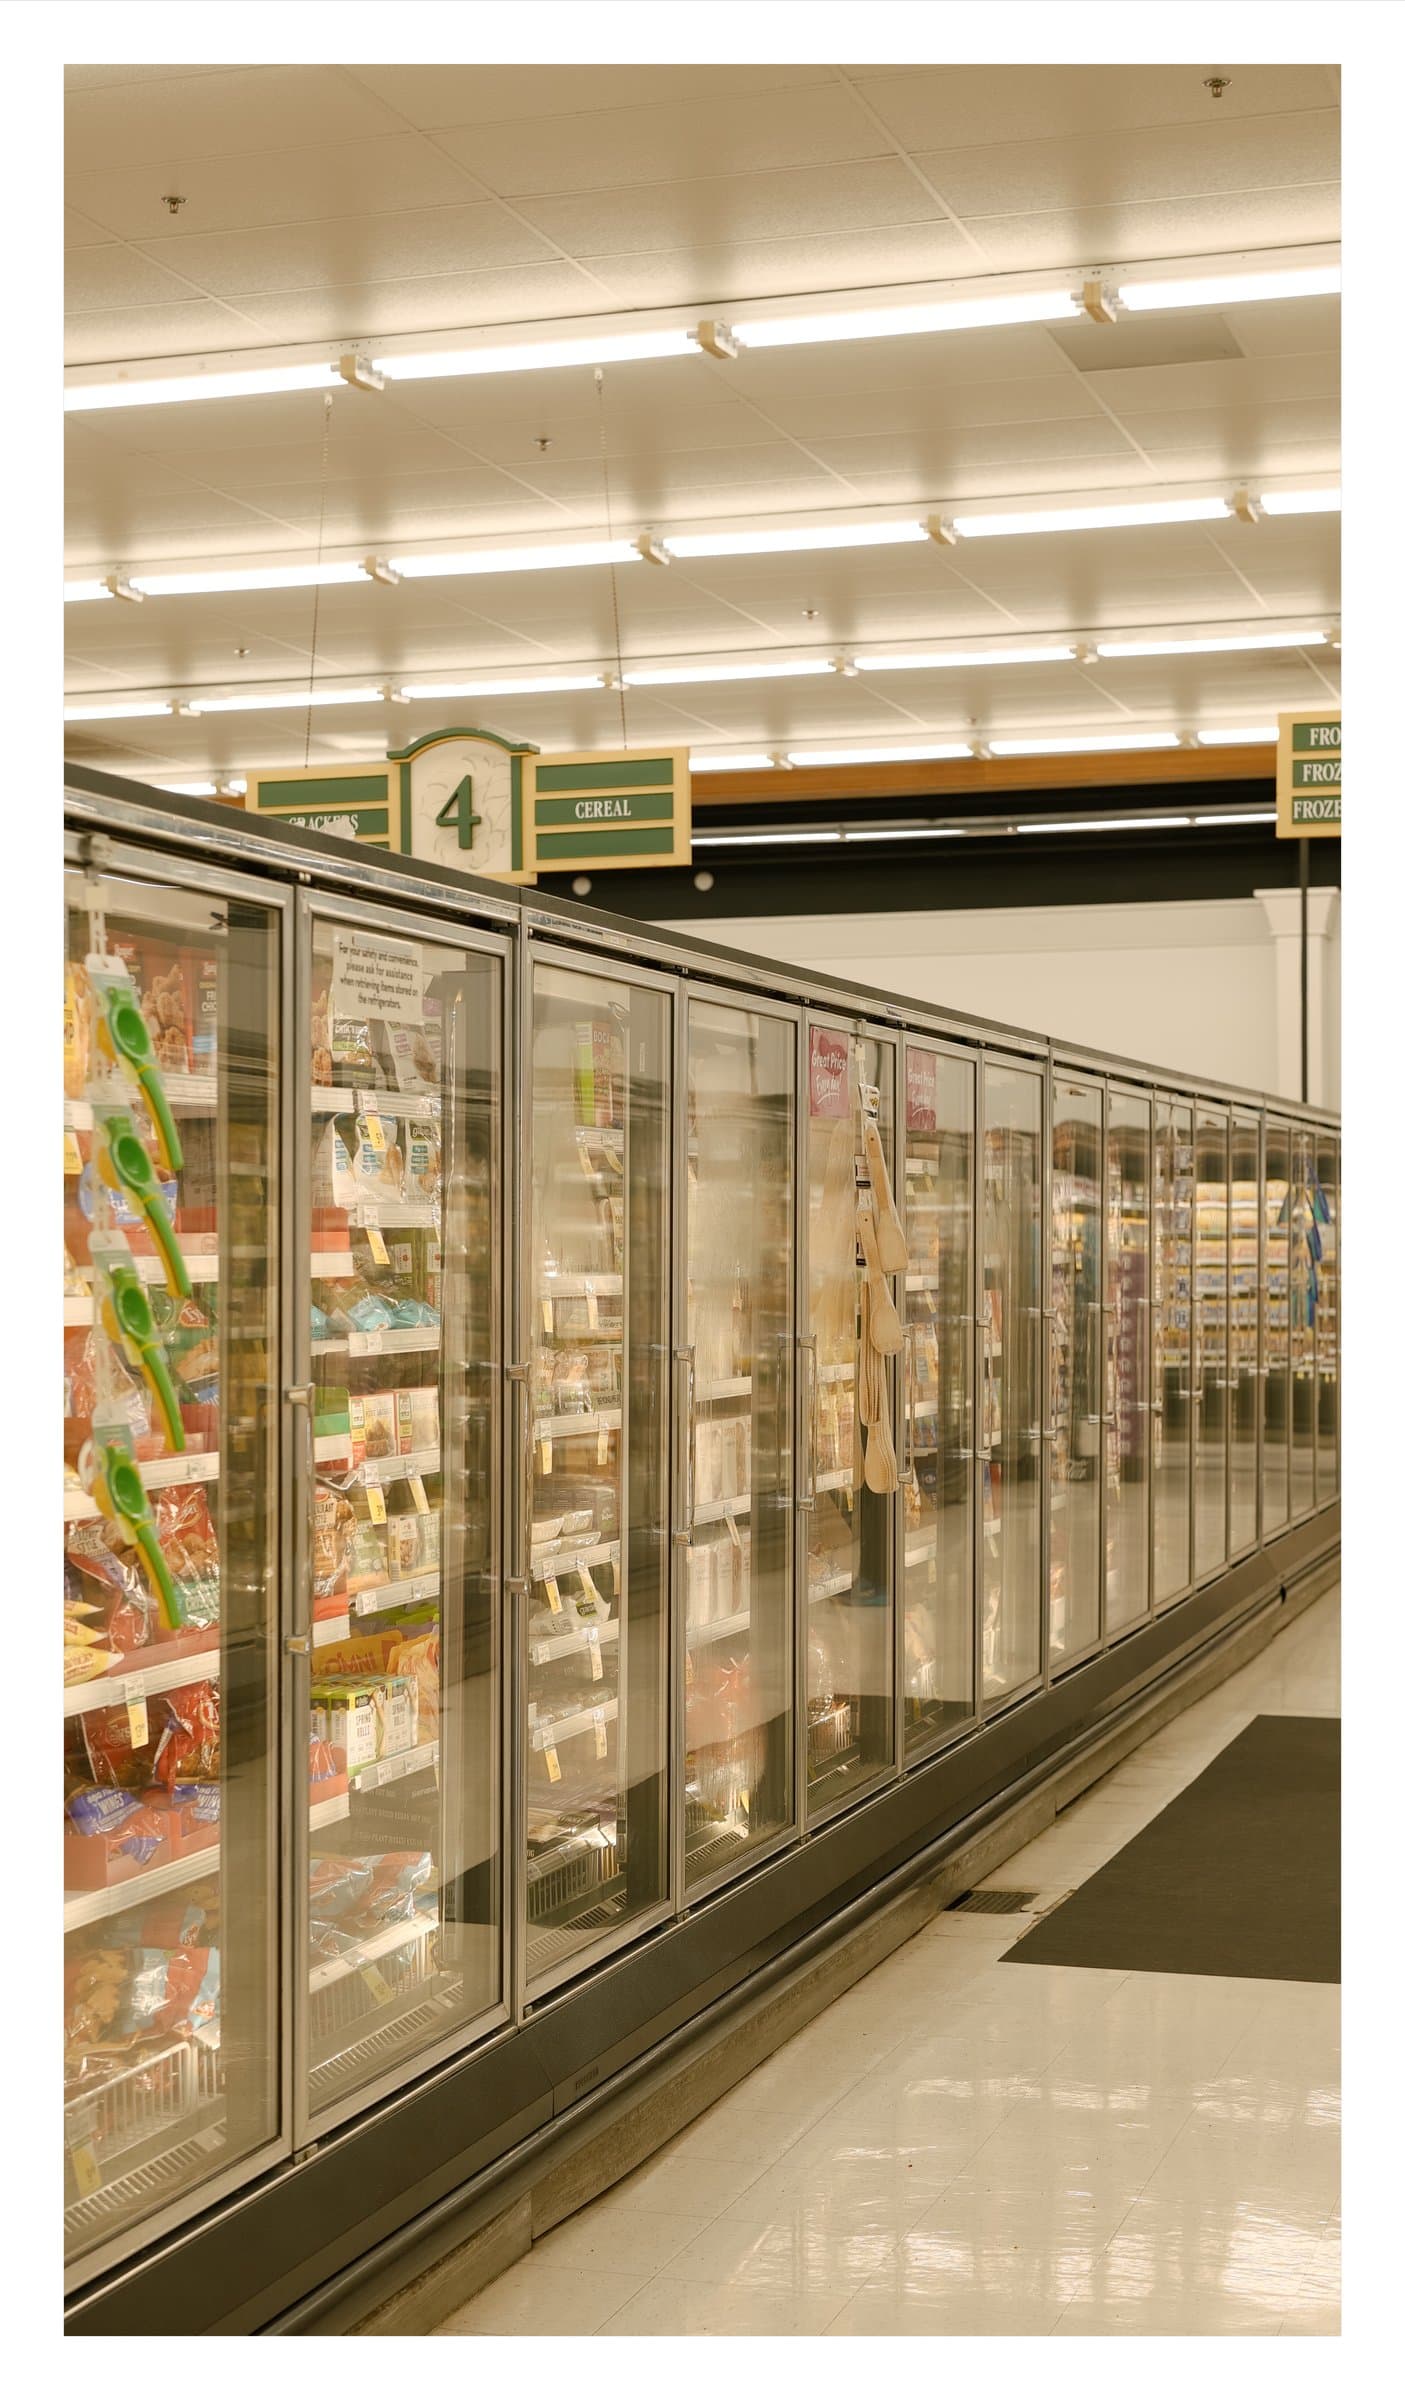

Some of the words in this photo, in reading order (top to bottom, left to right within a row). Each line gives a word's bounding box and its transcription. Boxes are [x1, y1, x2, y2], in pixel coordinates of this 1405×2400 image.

[1302, 762, 1341, 782] FROZ
[436, 774, 482, 850] 4
[575, 800, 632, 819] CEREAL
[339, 942, 349, 955] For
[350, 948, 361, 962] your
[361, 947, 377, 963] safety
[378, 952, 388, 961] and
[346, 962, 364, 974] please
[365, 964, 375, 974] ask
[376, 963, 385, 976] for
[386, 968, 413, 981] assistance
[340, 976, 355, 986] when
[355, 978, 379, 994] retrieving
[380, 980, 395, 993] items
[395, 984, 412, 996] stored
[358, 992, 367, 1004] the
[811, 1050, 829, 1068] Great
[830, 1051, 847, 1071] Price
